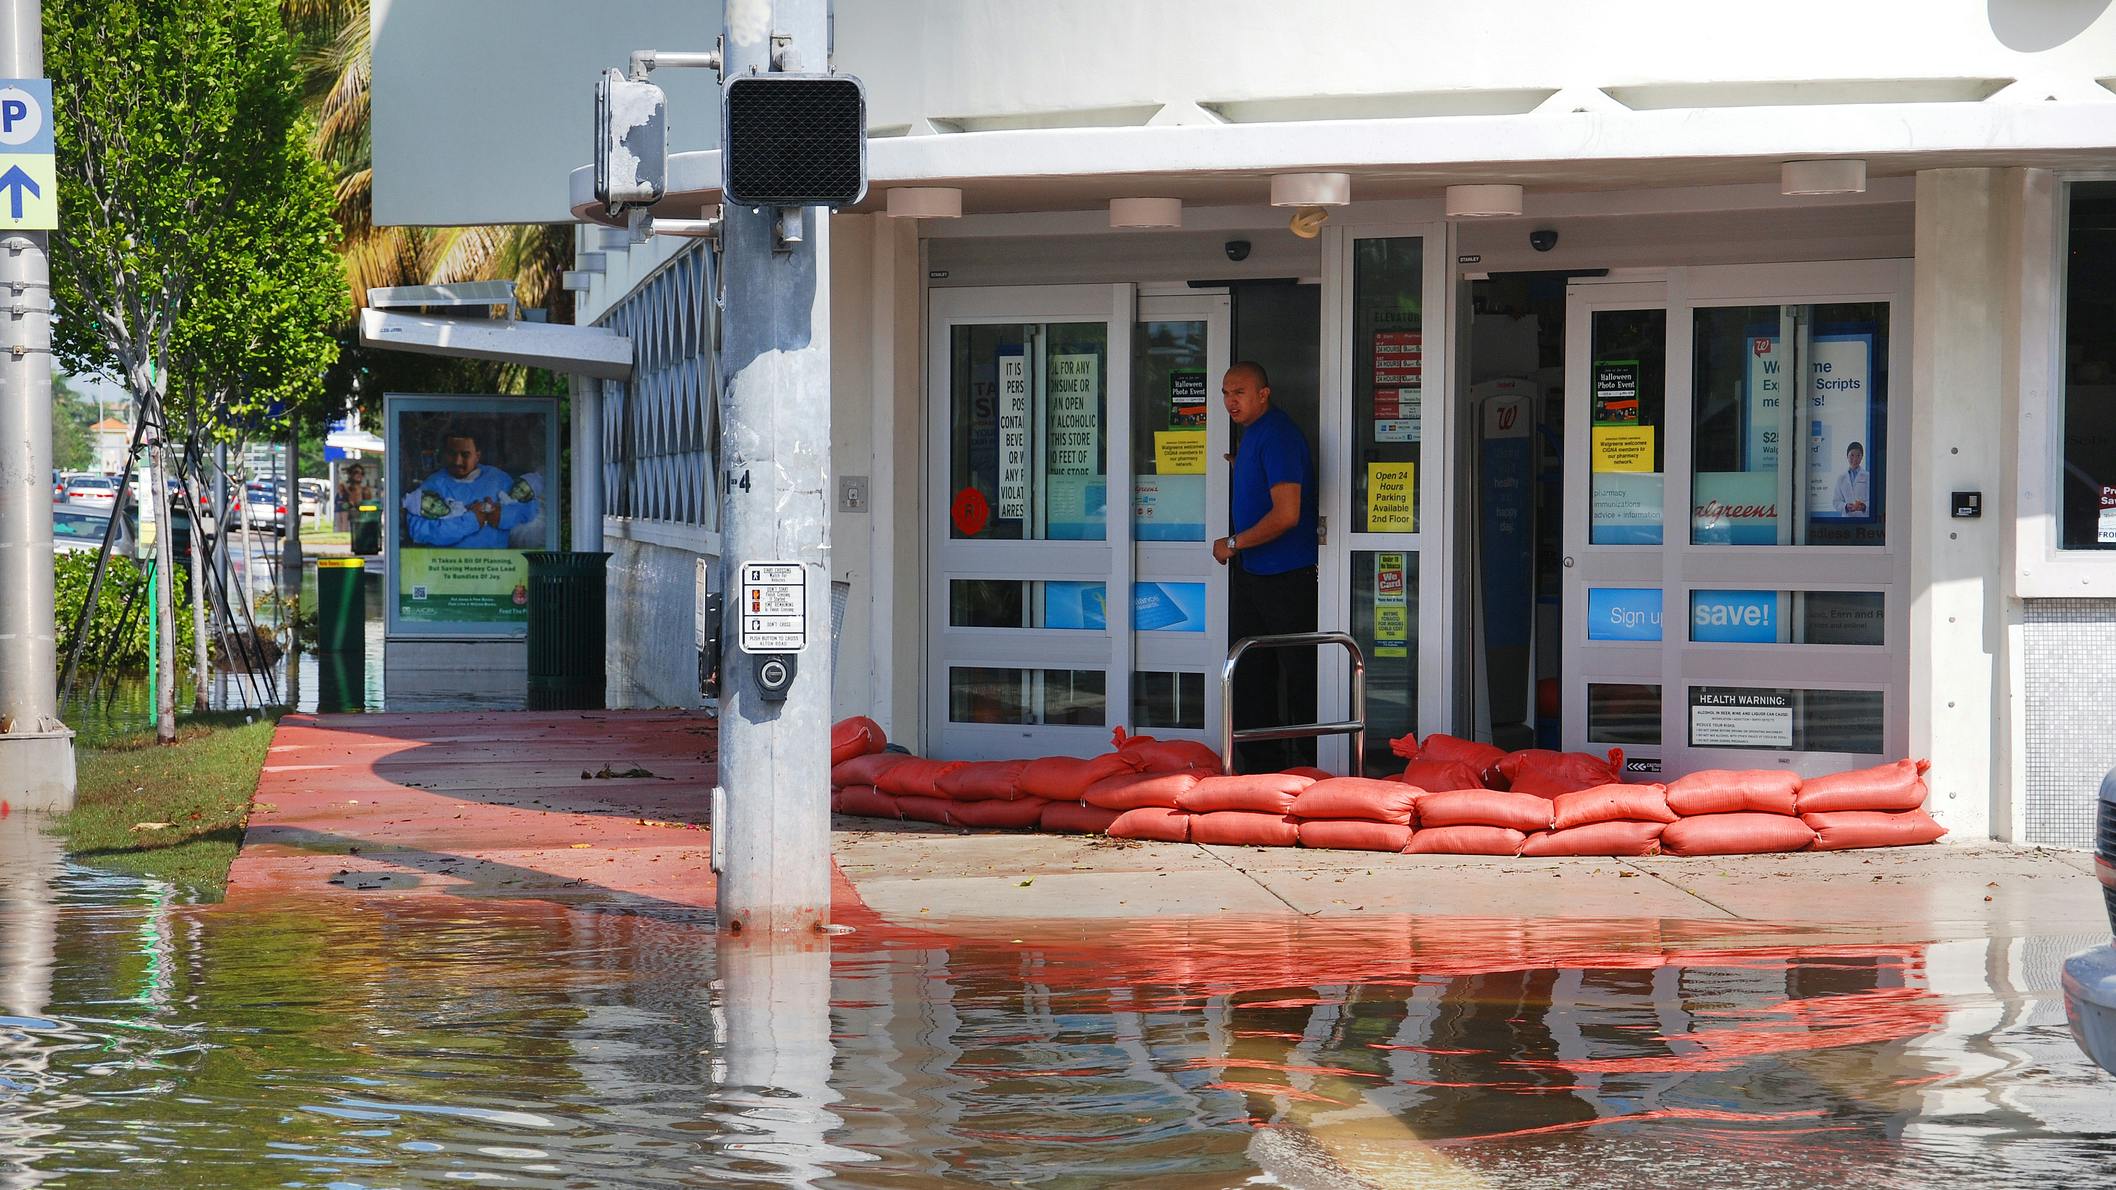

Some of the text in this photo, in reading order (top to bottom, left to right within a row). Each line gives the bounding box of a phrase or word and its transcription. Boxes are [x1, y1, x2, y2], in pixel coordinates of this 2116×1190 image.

[2, 100, 27, 132] P
[1006, 361, 1090, 376] IT IS FOR ANY
[1601, 373, 1632, 381] Halloween
[1006, 380, 1024, 393] PERS
[1080, 379, 1090, 392] OR
[1174, 380, 1202, 388] Halloween
[1597, 380, 1635, 390] Photo Event
[1816, 377, 1861, 392] Scripts
[1172, 388, 1205, 396] Photo Event
[1012, 398, 1024, 411] POS
[1065, 397, 1084, 410] OPEN
[1057, 414, 1096, 428] ALCOHOLIC
[1006, 433, 1023, 447] BEVE
[1068, 432, 1090, 445] STORE
[1009, 451, 1019, 463] OR
[1059, 450, 1077, 463] FEET
[1078, 450, 1087, 463] OF
[1616, 452, 1639, 460] pharmacy
[1005, 469, 1018, 482] ANY
[1375, 471, 1408, 482] Open 24
[1379, 482, 1404, 491] Hours
[1001, 486, 1024, 499] VIOLAT
[1594, 488, 1626, 497] pharmacy
[1376, 493, 1406, 504] Parking
[1002, 503, 1024, 517] ARRES
[1373, 504, 1409, 513] Available
[1695, 500, 1777, 522] algreens
[1372, 514, 1410, 523] 2nd Floor
[1594, 511, 1616, 519] advice
[1623, 511, 1661, 519] information
[441, 565, 463, 573] Saving
[1383, 572, 1398, 581] We
[1379, 578, 1401, 589] Card
[1611, 607, 1645, 628] Sign
[1695, 603, 1769, 627] save!
[1700, 694, 1785, 706] HEALTH WARNING:
